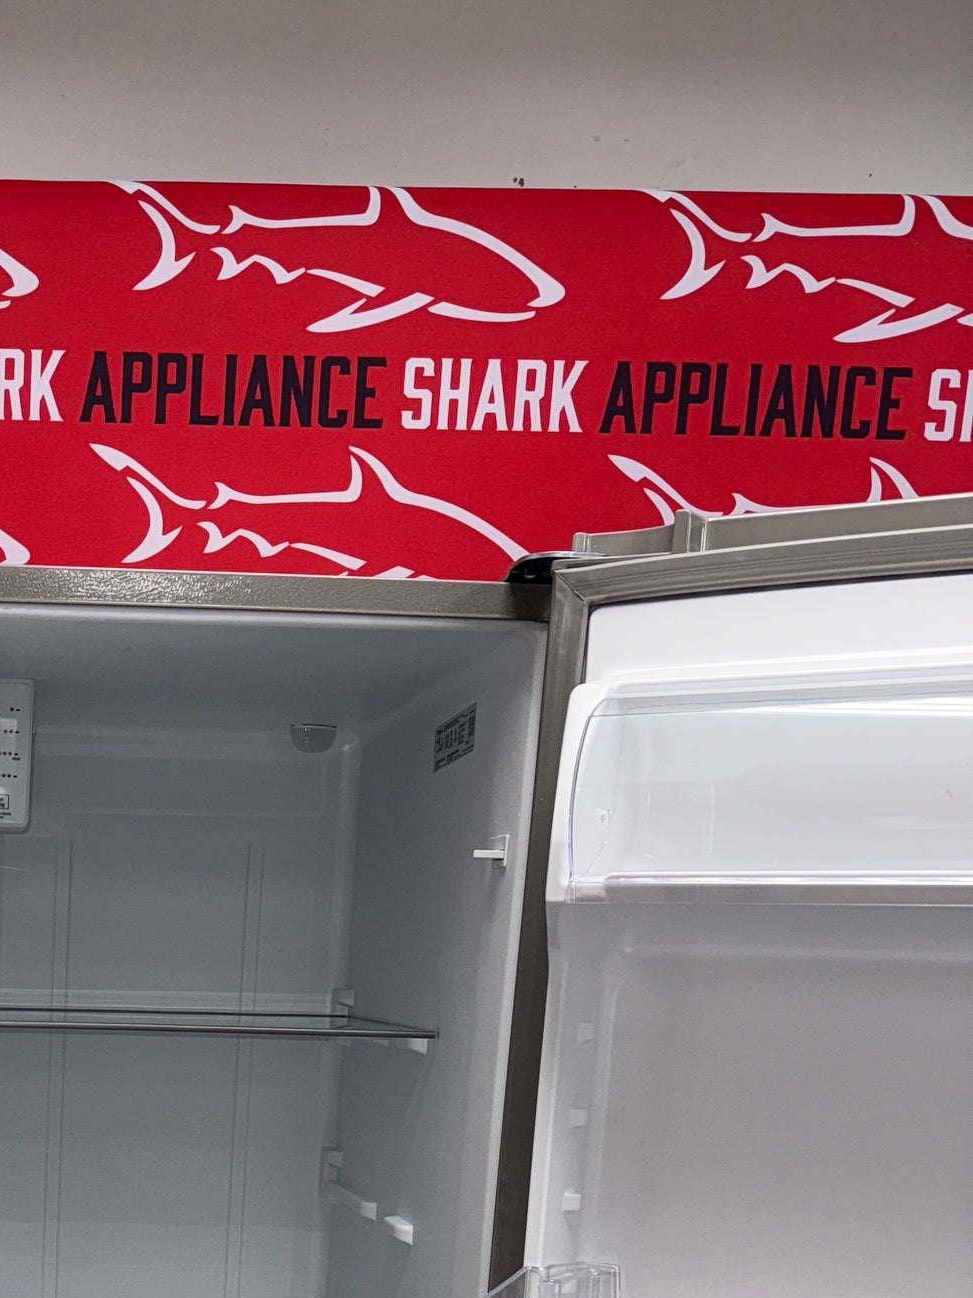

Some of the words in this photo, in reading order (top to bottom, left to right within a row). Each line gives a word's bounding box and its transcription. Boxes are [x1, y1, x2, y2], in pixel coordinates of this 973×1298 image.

[80, 351, 388, 429] APPLIANCE
[402, 357, 588, 433] SHARK
[599, 361, 914, 440] APPLIANCE
